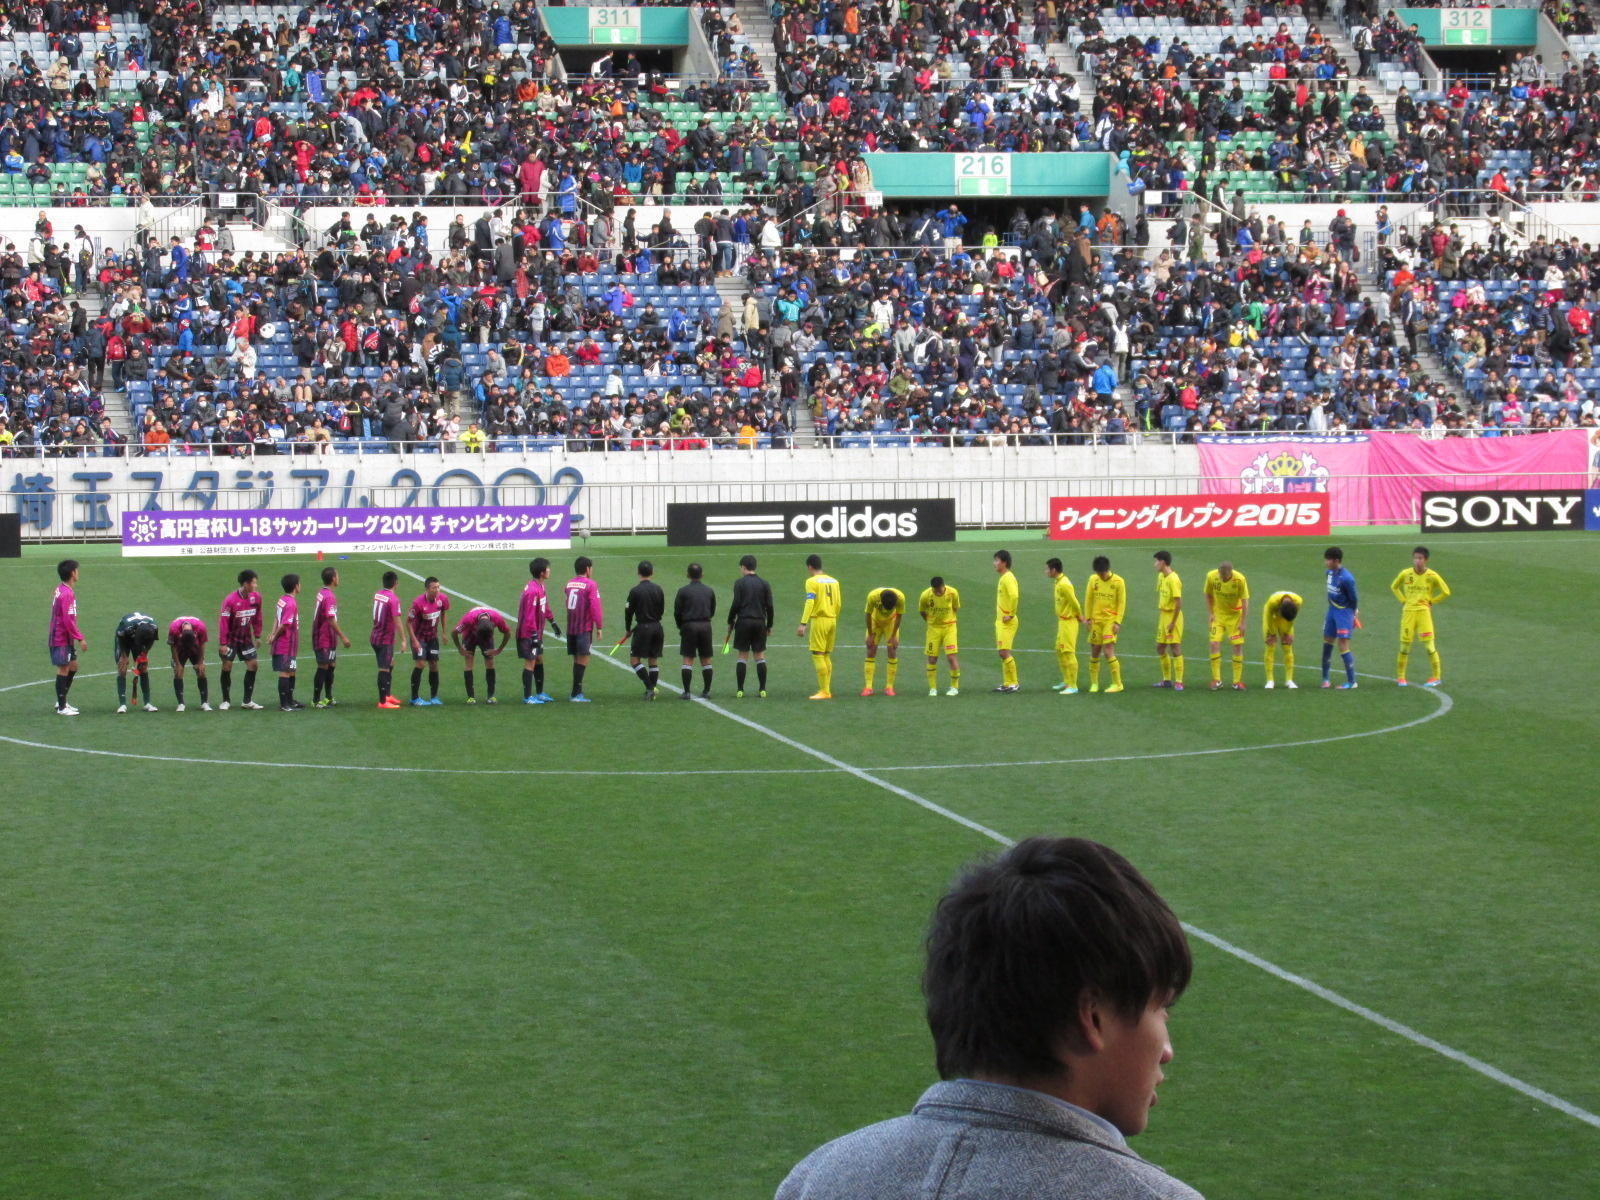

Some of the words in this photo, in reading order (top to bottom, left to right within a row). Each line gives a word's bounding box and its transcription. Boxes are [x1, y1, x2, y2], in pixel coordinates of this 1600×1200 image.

[597, 9, 631, 25] 311
[1449, 10, 1483, 26] 312
[961, 155, 1004, 175] 216
[790, 506, 914, 539] adidas
[1058, 505, 1233, 532] ウイニングイレブン
[1235, 503, 1321, 528] 2015
[1424, 496, 1582, 528] SONY
[160, 514, 426, 539] 高円宮杯U-18サッカーリーグ2014
[431, 512, 564, 534] チャンピオンシップ
[567, 589, 579, 609] 6
[825, 584, 833, 605] 4
[373, 600, 385, 622] 11
